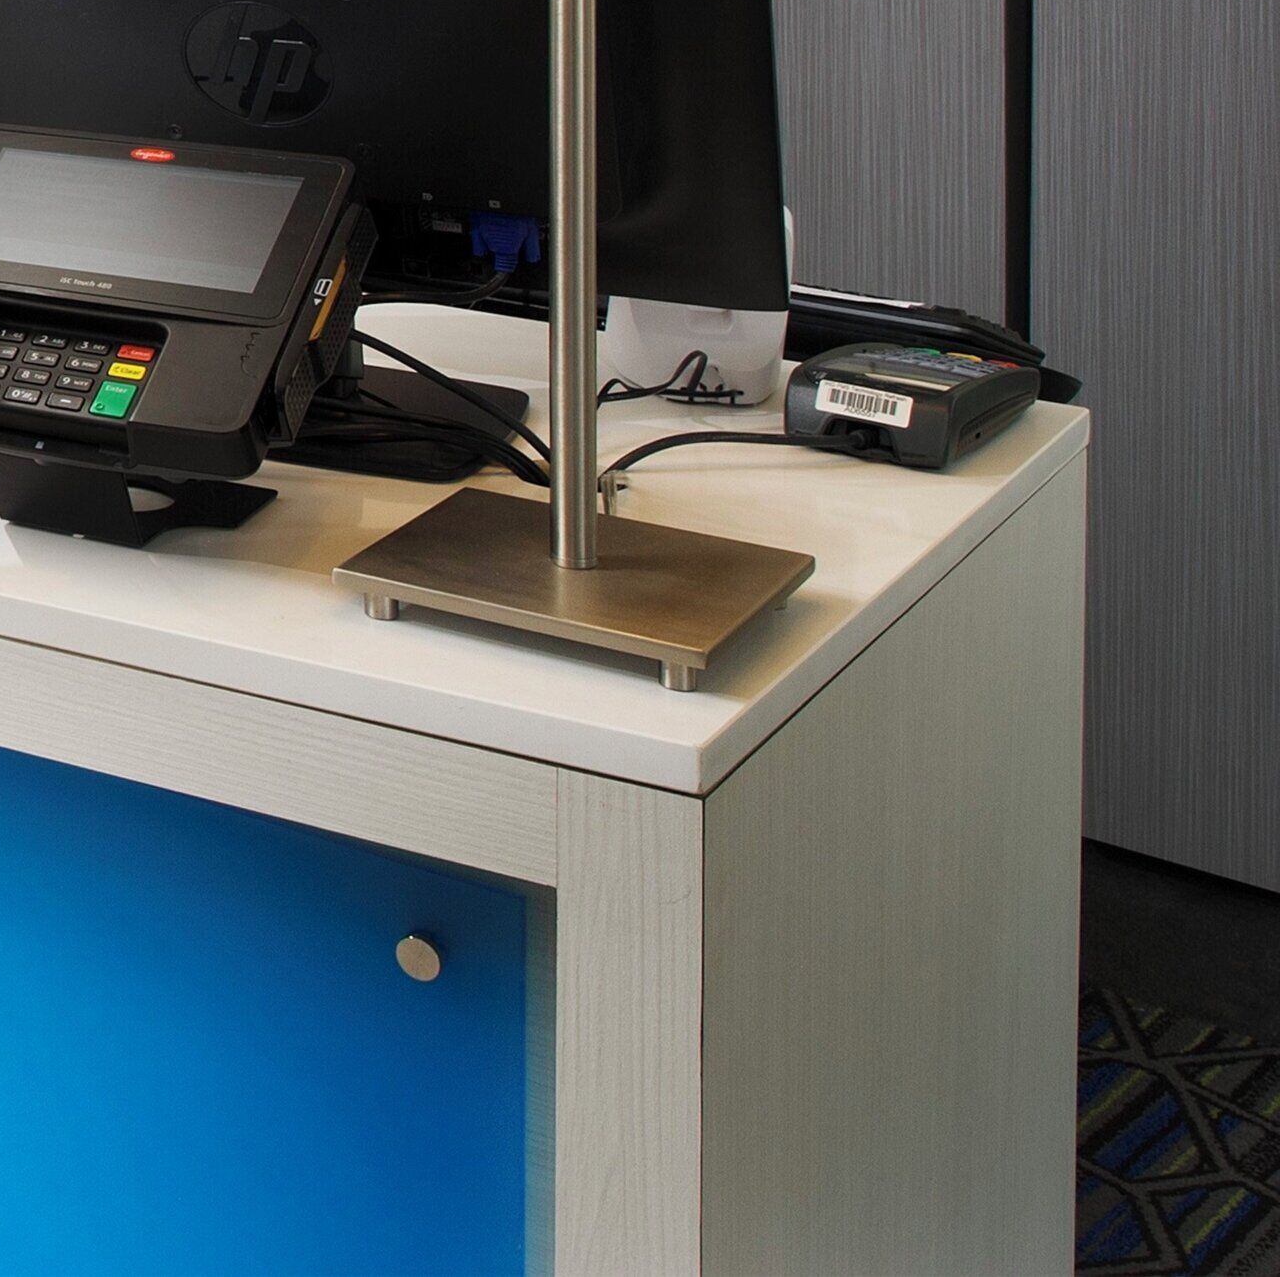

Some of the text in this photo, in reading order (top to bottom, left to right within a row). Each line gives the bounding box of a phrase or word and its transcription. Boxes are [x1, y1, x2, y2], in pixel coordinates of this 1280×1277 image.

[40, 335, 48, 343] 2
[80, 341, 89, 349] 3
[30, 352, 38, 360] 5
[71, 359, 78, 367] 6
[21, 371, 30, 379] 8
[63, 377, 70, 385] 9
[105, 385, 128, 394] Enter
